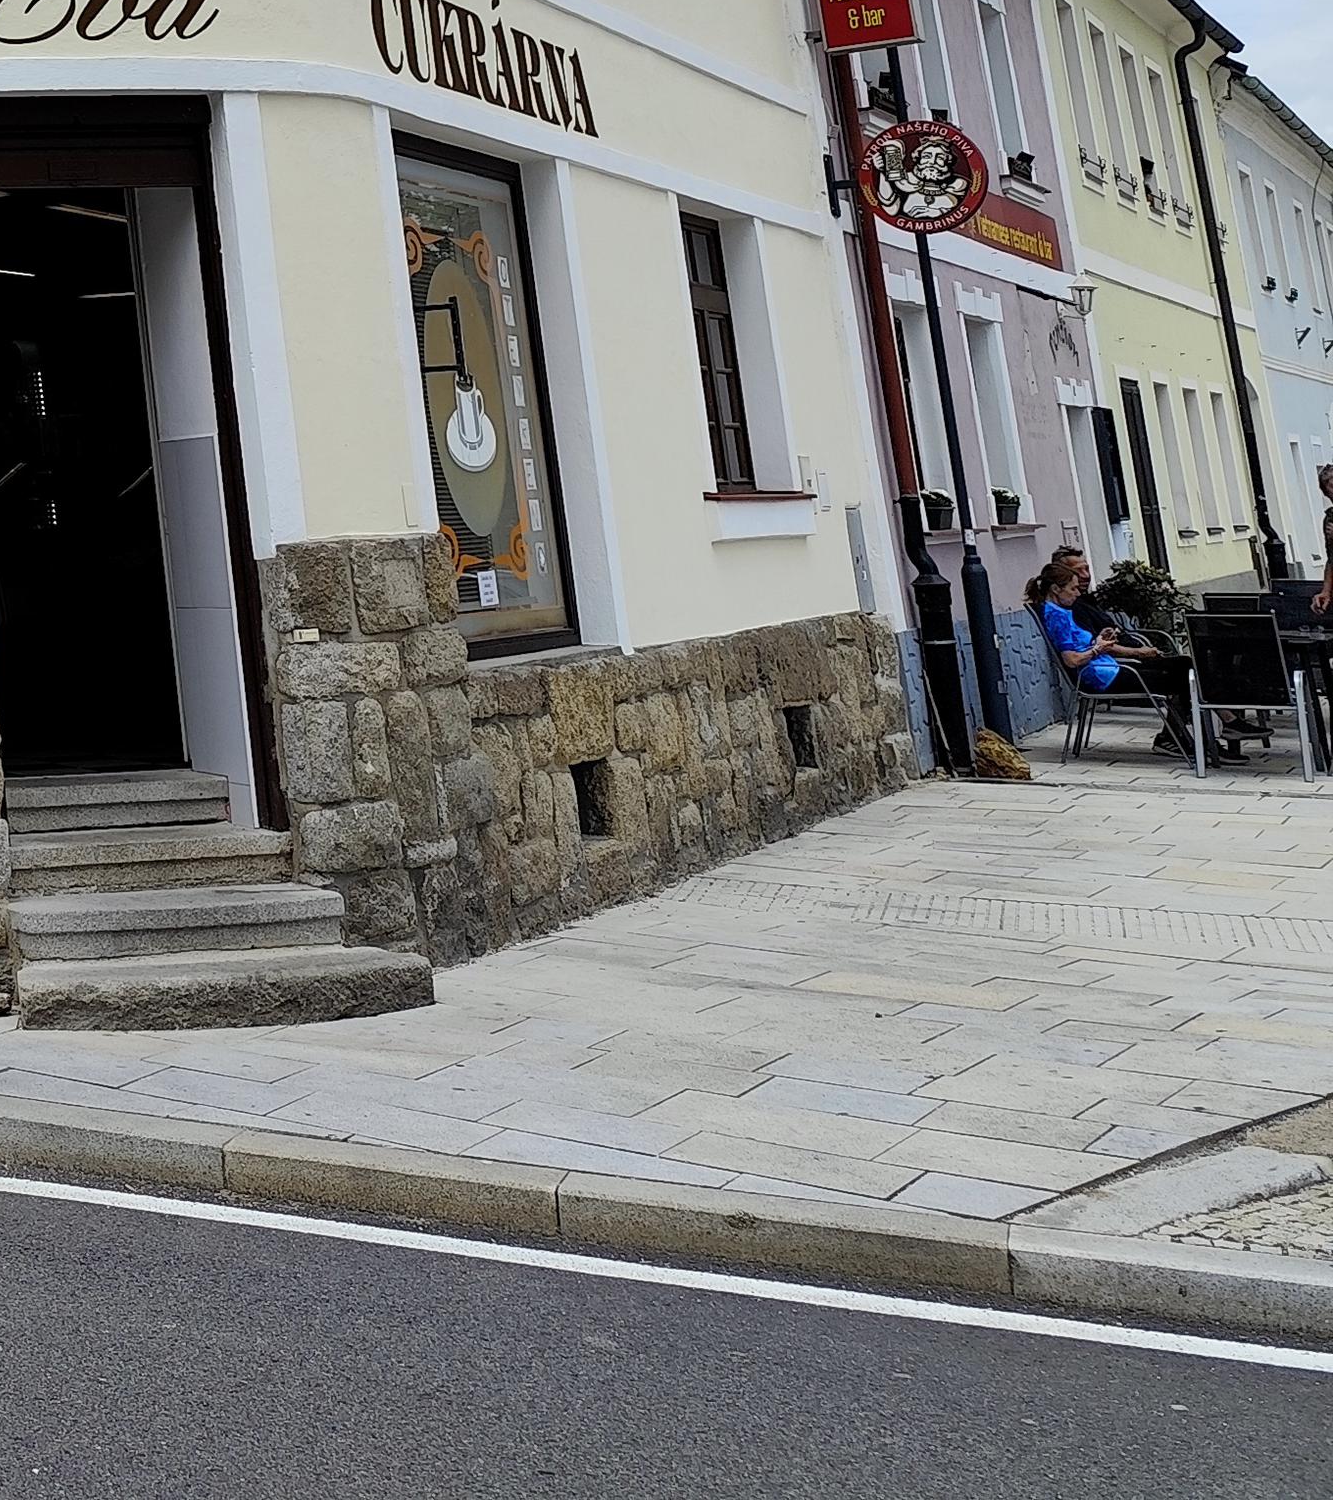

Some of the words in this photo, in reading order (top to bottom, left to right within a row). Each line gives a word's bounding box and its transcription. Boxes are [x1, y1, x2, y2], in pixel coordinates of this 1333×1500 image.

[848, 8, 859, 29] &
[862, 4, 885, 28] bar
[861, 133, 893, 171] PATRON
[896, 121, 949, 136] NAŠEHO
[952, 134, 974, 157] PIVA
[896, 206, 969, 231] GAMBRINUS
